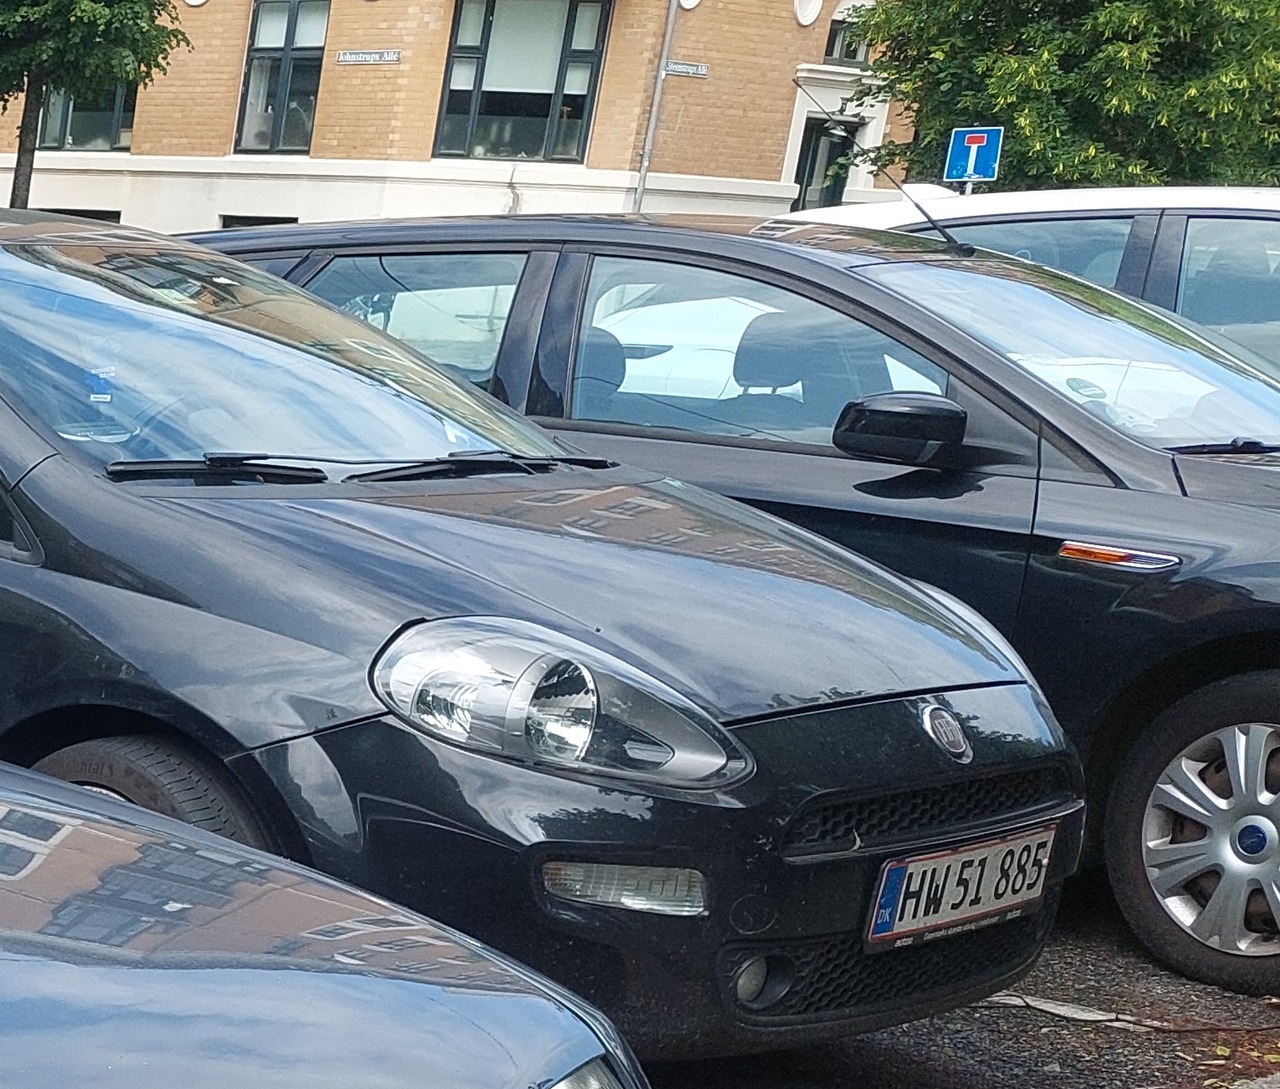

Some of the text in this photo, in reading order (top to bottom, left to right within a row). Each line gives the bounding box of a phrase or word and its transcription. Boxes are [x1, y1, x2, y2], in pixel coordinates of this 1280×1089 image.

[339, 51, 399, 62] Johnstrups Allé
[897, 840, 1048, 923] HW 51 885
[877, 907, 892, 924] DK
